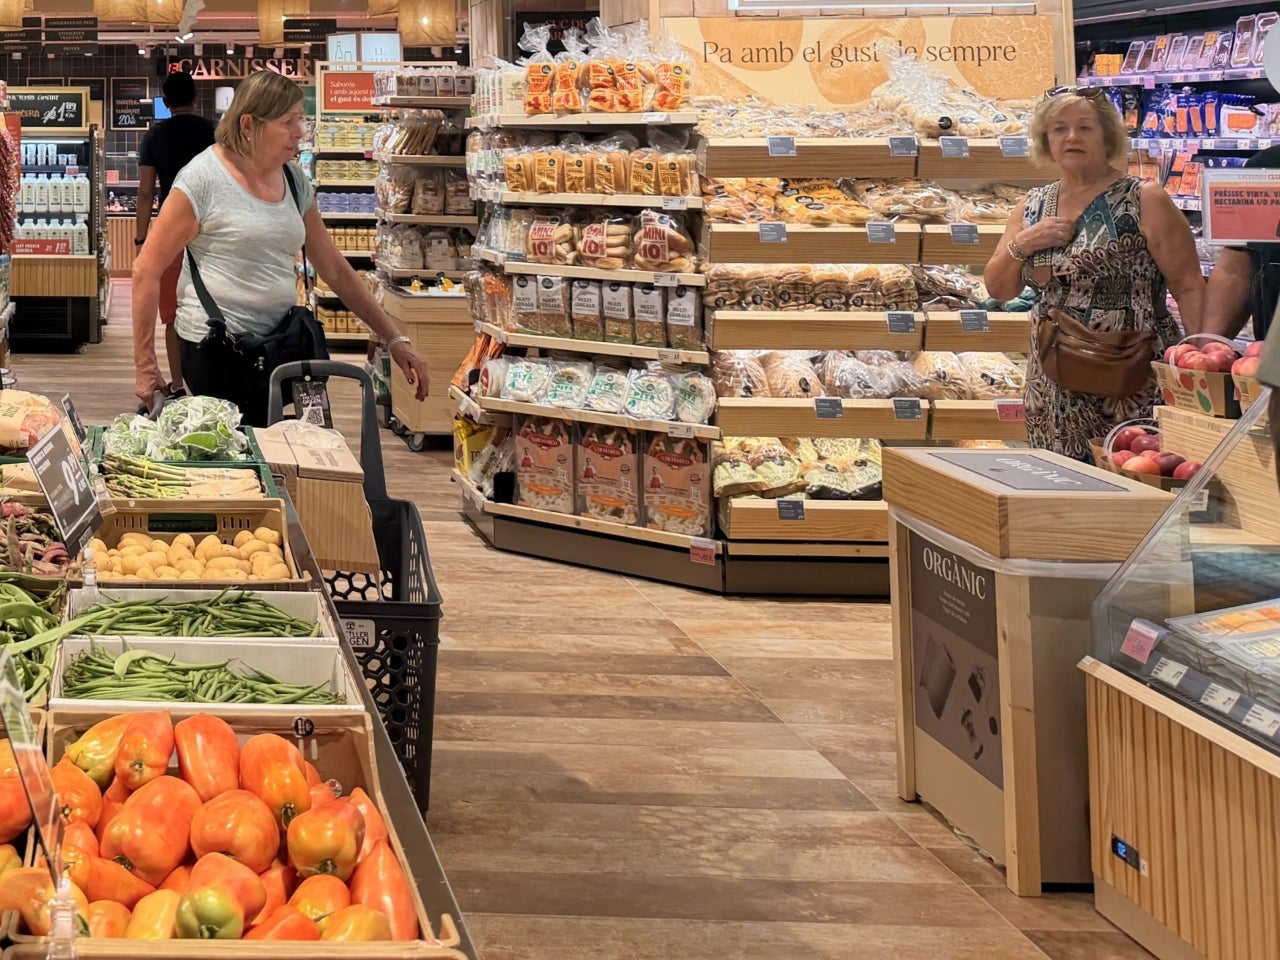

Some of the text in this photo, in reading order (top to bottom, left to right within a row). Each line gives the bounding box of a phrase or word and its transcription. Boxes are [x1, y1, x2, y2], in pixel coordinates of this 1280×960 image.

[702, 41, 733, 64] Pa
[740, 41, 794, 64] amb
[802, 41, 822, 63] el
[830, 41, 880, 68] gust
[926, 43, 1017, 67] sempre
[179, 58, 319, 79] CARNISSER
[1214, 189, 1245, 198] PRÉSSEC
[531, 226, 554, 239] MINI
[642, 225, 666, 241] MINI
[531, 241, 548, 256] 10
[582, 240, 599, 255] 10
[642, 243, 661, 259] 10
[923, 547, 986, 600] ORGÀNIC
